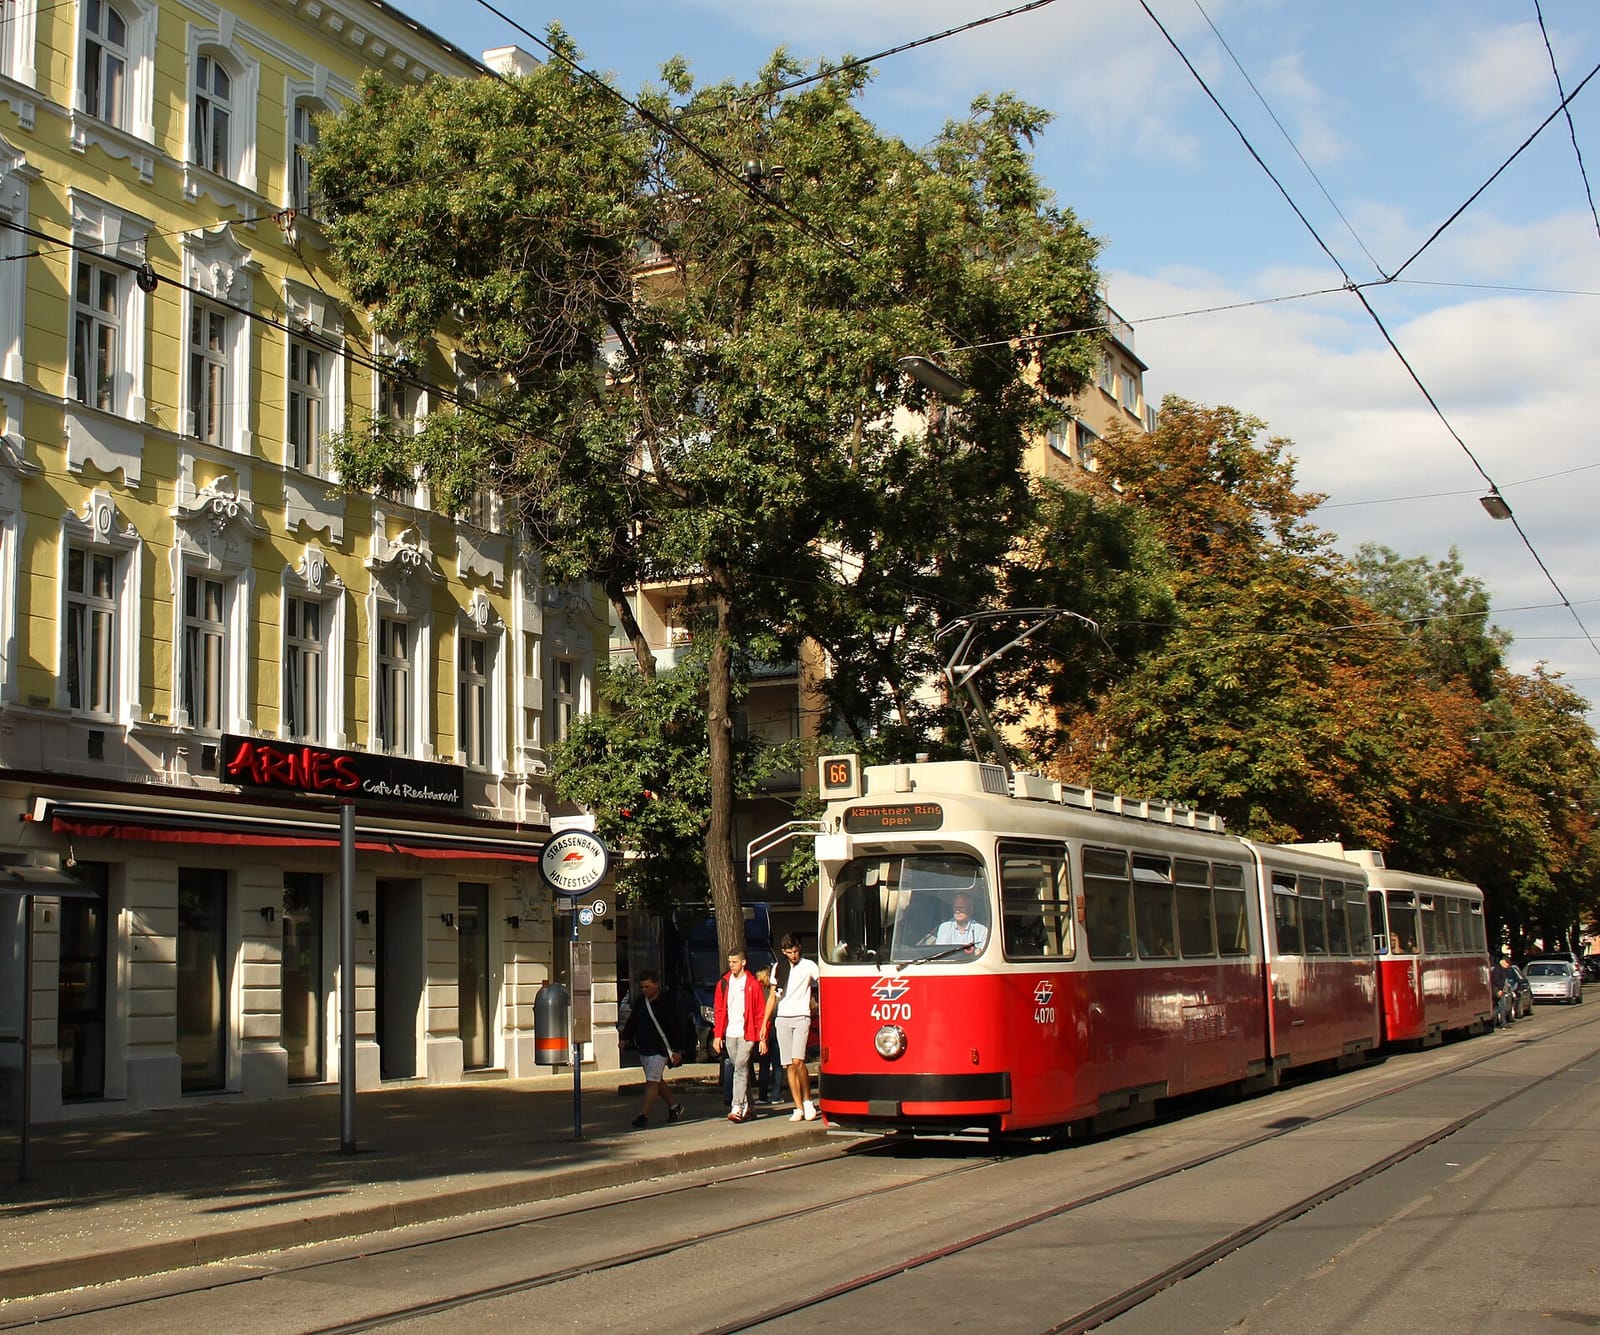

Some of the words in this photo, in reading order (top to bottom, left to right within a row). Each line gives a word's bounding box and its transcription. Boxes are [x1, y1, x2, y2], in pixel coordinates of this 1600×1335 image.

[227, 742, 362, 791] ARNES
[830, 764, 847, 783] 66
[362, 779, 392, 796] Cafe
[393, 784, 401, 796] &
[914, 805, 942, 815] Ring
[881, 817, 911, 826] Oper
[546, 837, 600, 860] STRASSENBAHN
[550, 867, 599, 888] HALTESTELLE
[594, 902, 604, 912] 6
[580, 911, 593, 921] 66
[870, 1003, 912, 1021] 4070
[1034, 1007, 1055, 1024] 4070
